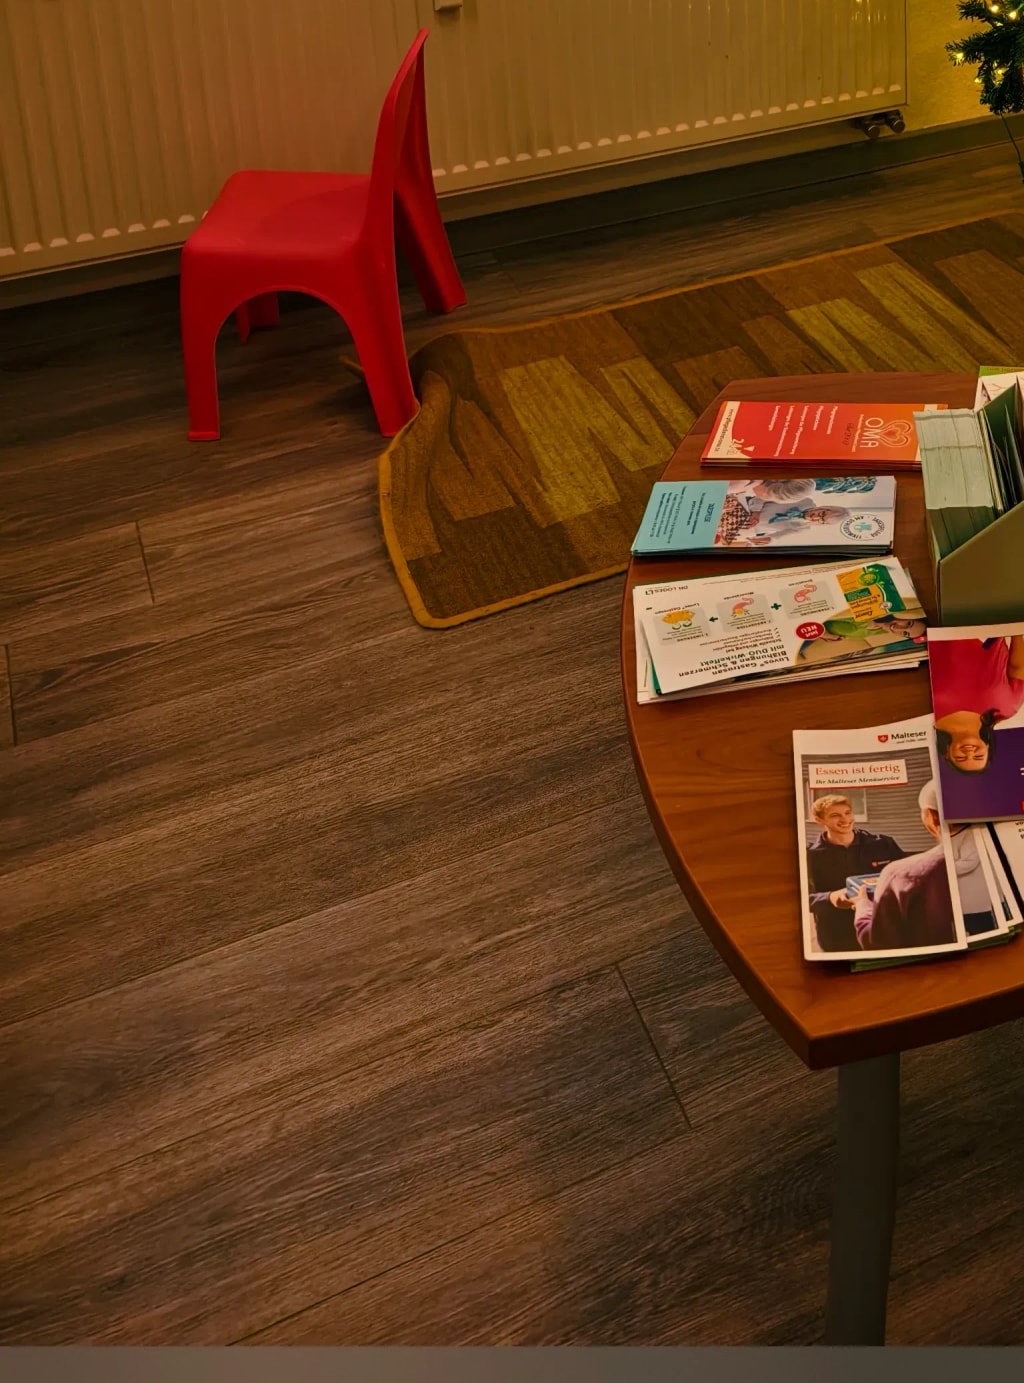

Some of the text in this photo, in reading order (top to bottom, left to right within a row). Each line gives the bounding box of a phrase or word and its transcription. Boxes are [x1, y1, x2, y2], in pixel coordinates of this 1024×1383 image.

[859, 417, 883, 447] OMA
[800, 624, 817, 633] NEU
[747, 647, 768, 656] DUO
[769, 643, 784, 652] mit
[738, 649, 787, 664] Blähungen
[678, 662, 727, 677] Schmerzen
[711, 662, 757, 675] Gastrosan
[890, 730, 927, 739] Malteser
[815, 763, 900, 777] Essen ist fertig
[827, 776, 856, 785] Malteser
